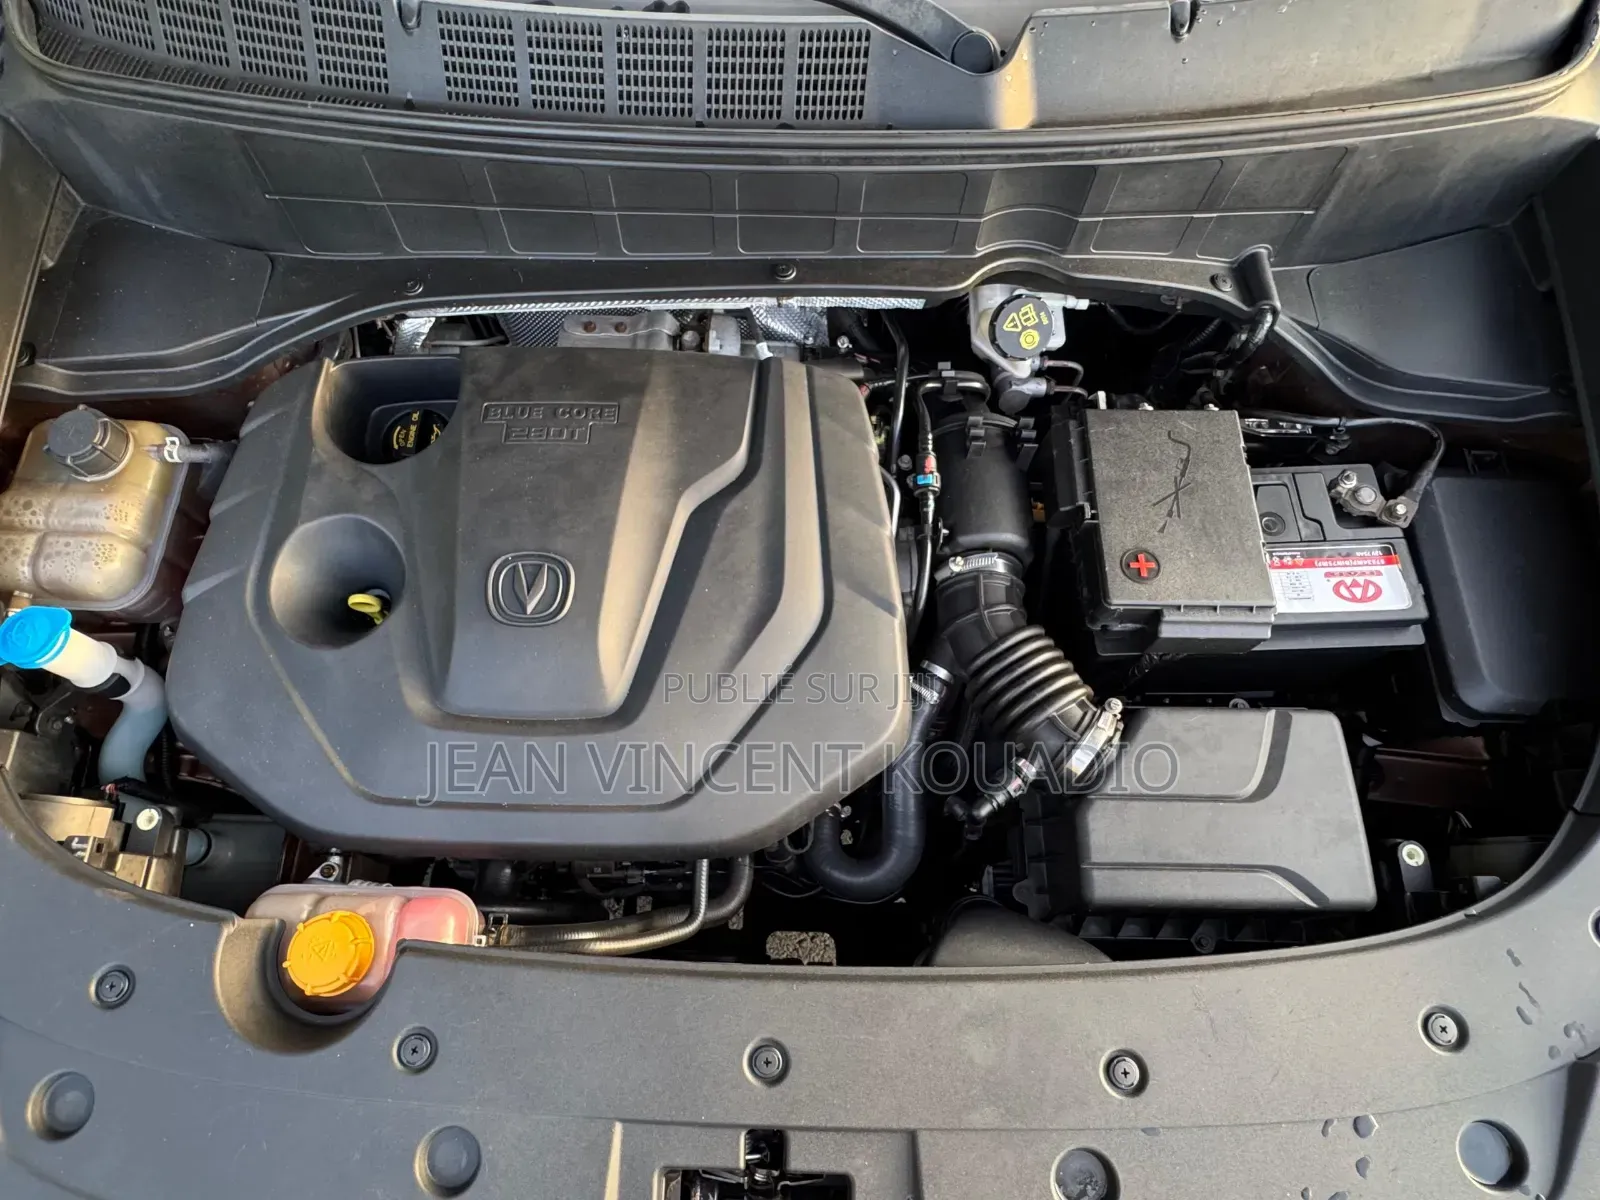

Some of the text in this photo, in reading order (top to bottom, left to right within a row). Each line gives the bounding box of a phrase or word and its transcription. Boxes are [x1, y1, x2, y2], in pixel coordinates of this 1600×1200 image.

[487, 405, 616, 420] BLUE CORE
[407, 425, 417, 448] ENGINE
[508, 426, 585, 441] 280T
